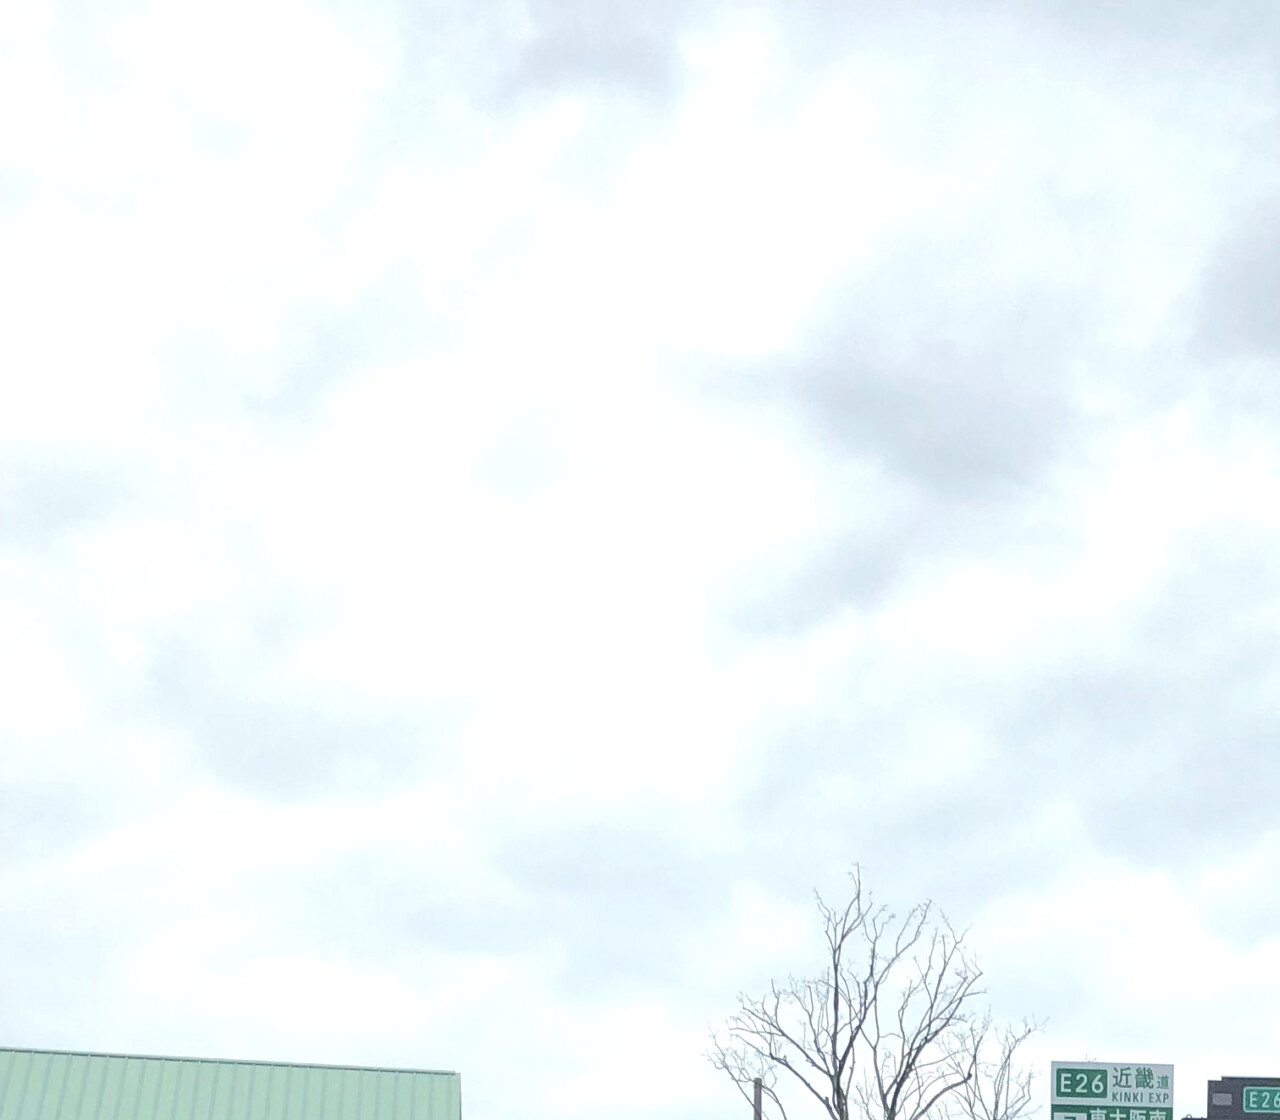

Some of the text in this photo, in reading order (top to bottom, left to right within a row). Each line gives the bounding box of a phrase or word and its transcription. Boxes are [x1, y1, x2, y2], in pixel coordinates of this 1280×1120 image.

[1060, 1073, 1104, 1093] E26
[1112, 1067, 1169, 1090] 近畿道
[1112, 1092, 1169, 1103] KINKI EXP
